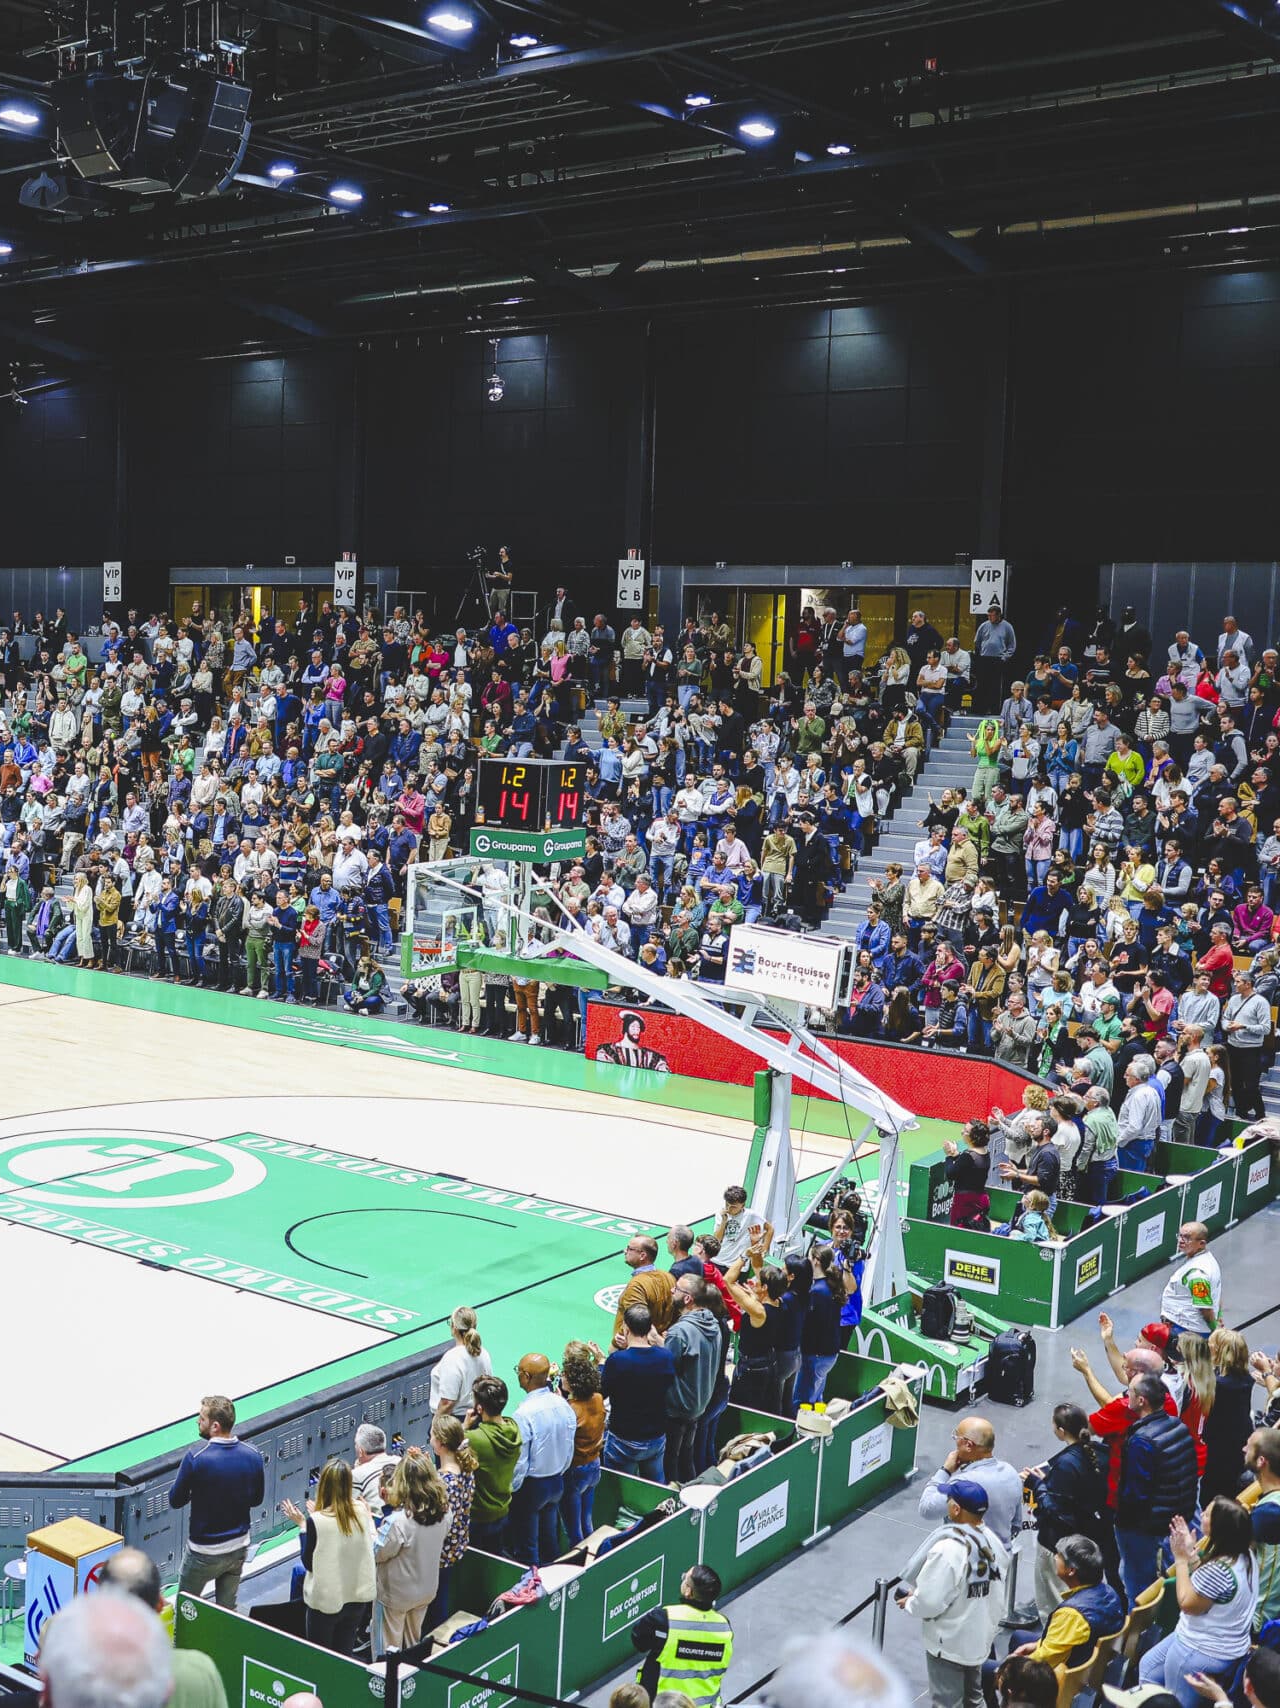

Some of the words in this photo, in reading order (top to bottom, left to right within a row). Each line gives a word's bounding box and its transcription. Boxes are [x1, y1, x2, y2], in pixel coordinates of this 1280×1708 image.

[105, 569, 120, 579] VIP
[337, 570, 354, 580] VIP
[621, 569, 641, 580] VIP
[974, 569, 1001, 582] VIP
[105, 587, 110, 596] E
[114, 587, 120, 596] D
[335, 589, 342, 599] D
[347, 589, 354, 599] C
[620, 590, 627, 600] C
[634, 590, 641, 601] B
[973, 593, 982, 606] B
[988, 593, 1001, 606] A
[502, 767, 526, 787] 1.2
[561, 768, 577, 788] 1.2
[499, 791, 530, 820] 14
[558, 792, 579, 821] 14
[492, 841, 536, 853] Groupama
[554, 840, 582, 851] Groupama
[758, 956, 831, 980] Bour-Esquisse
[238, 1137, 429, 1185] SIDAMO
[429, 1181, 653, 1236] SIDAMO
[178, 1256, 413, 1325] SIDAMO
[757, 1507, 785, 1532] FRANCE
[759, 1506, 770, 1520] VAL
[609, 1602, 624, 1619] BOX
[623, 1581, 658, 1610] COURTSIDE
[249, 1688, 265, 1702] BOX
